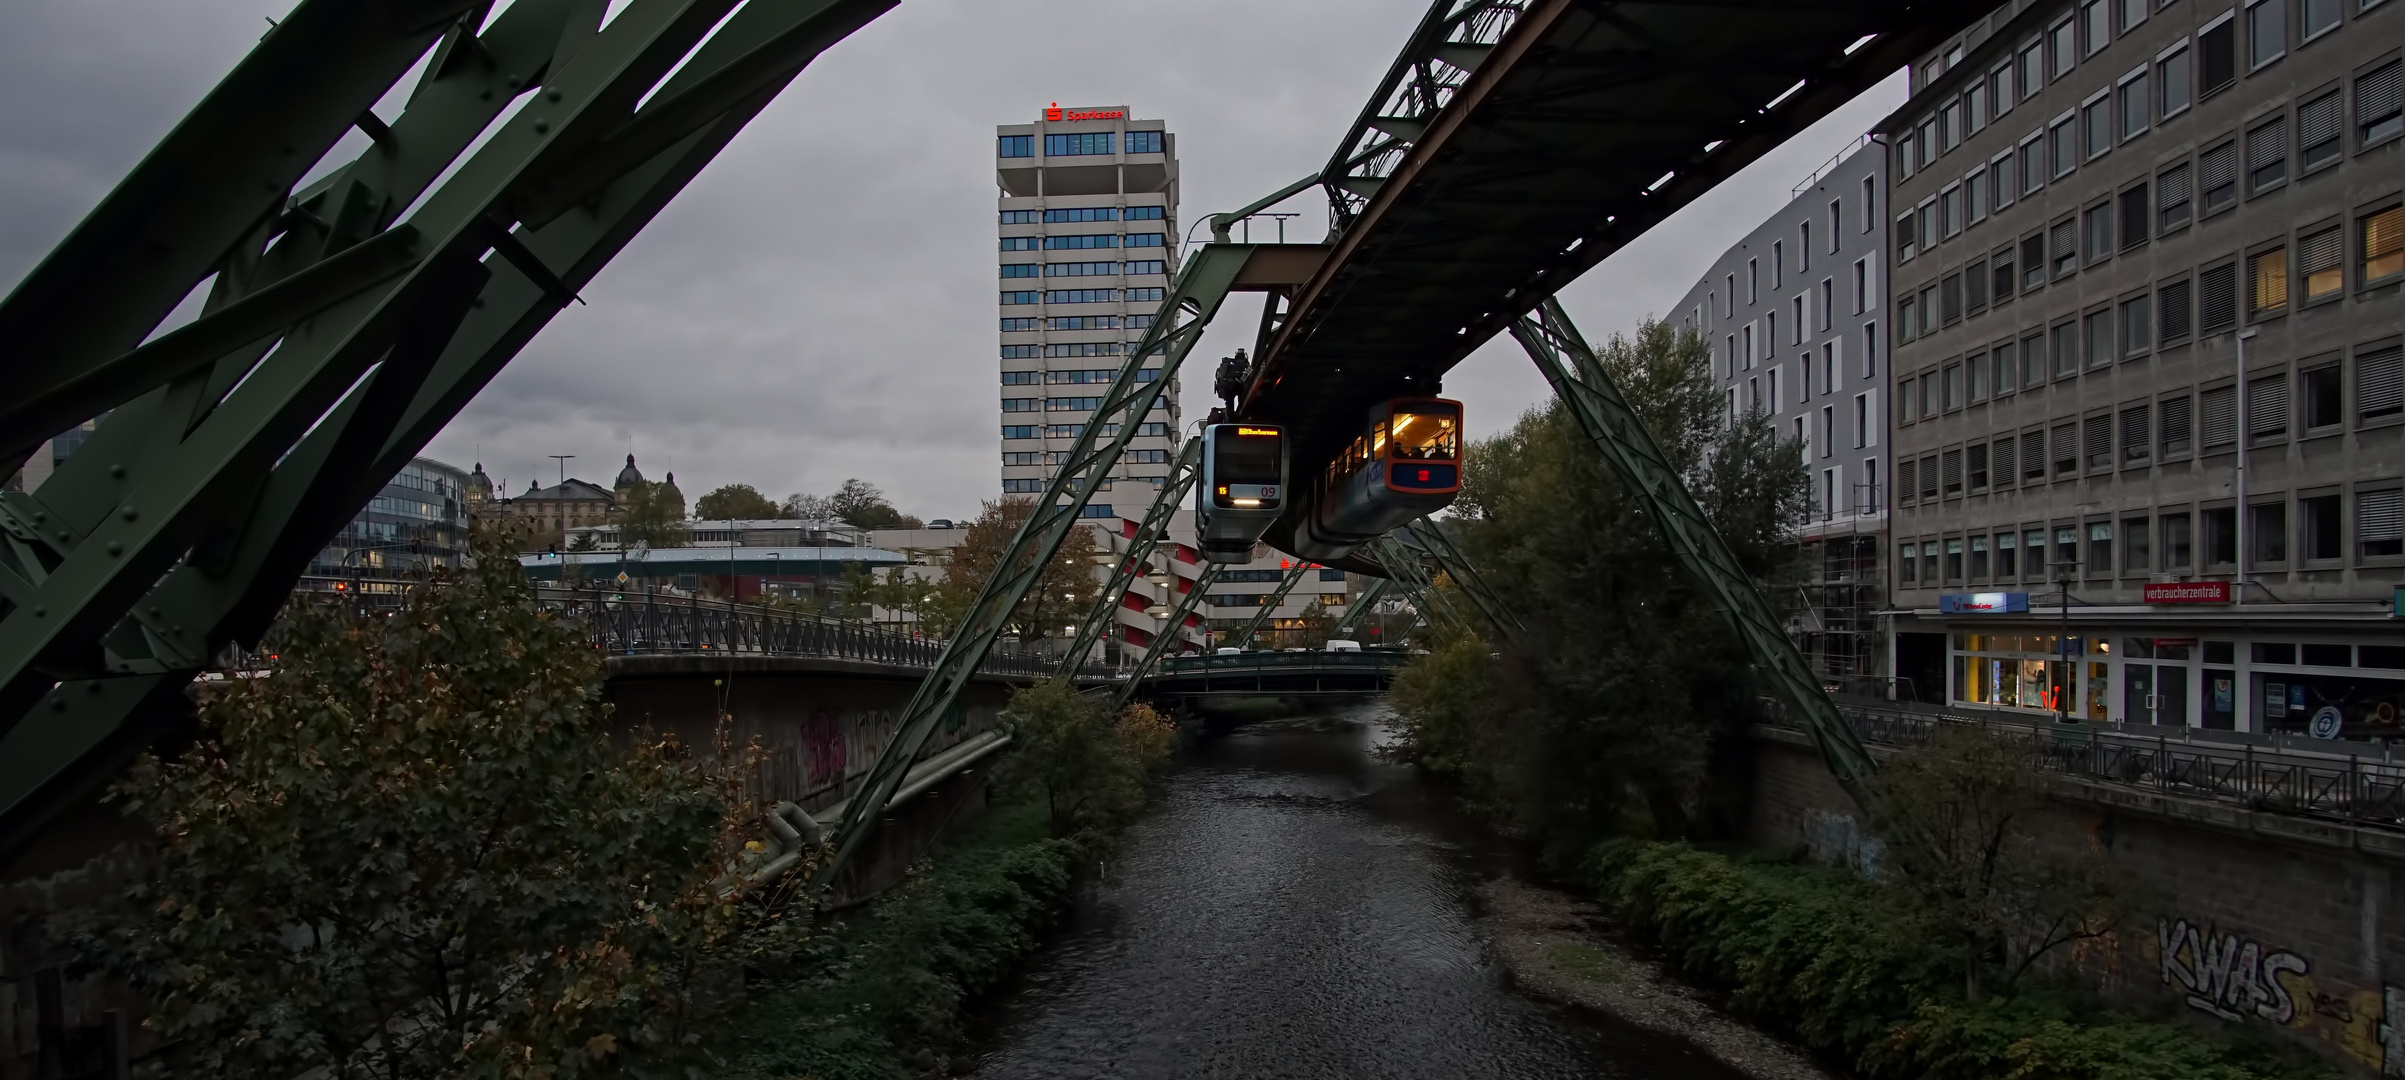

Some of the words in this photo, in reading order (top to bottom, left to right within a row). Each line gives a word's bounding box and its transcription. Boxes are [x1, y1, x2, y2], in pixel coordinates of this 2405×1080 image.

[1066, 110, 1123, 122] Sparkasse
[1261, 487, 1275, 497] 09
[2146, 584, 2221, 599] verbraucherzentrale
[2157, 917, 2310, 1025] KWAS
